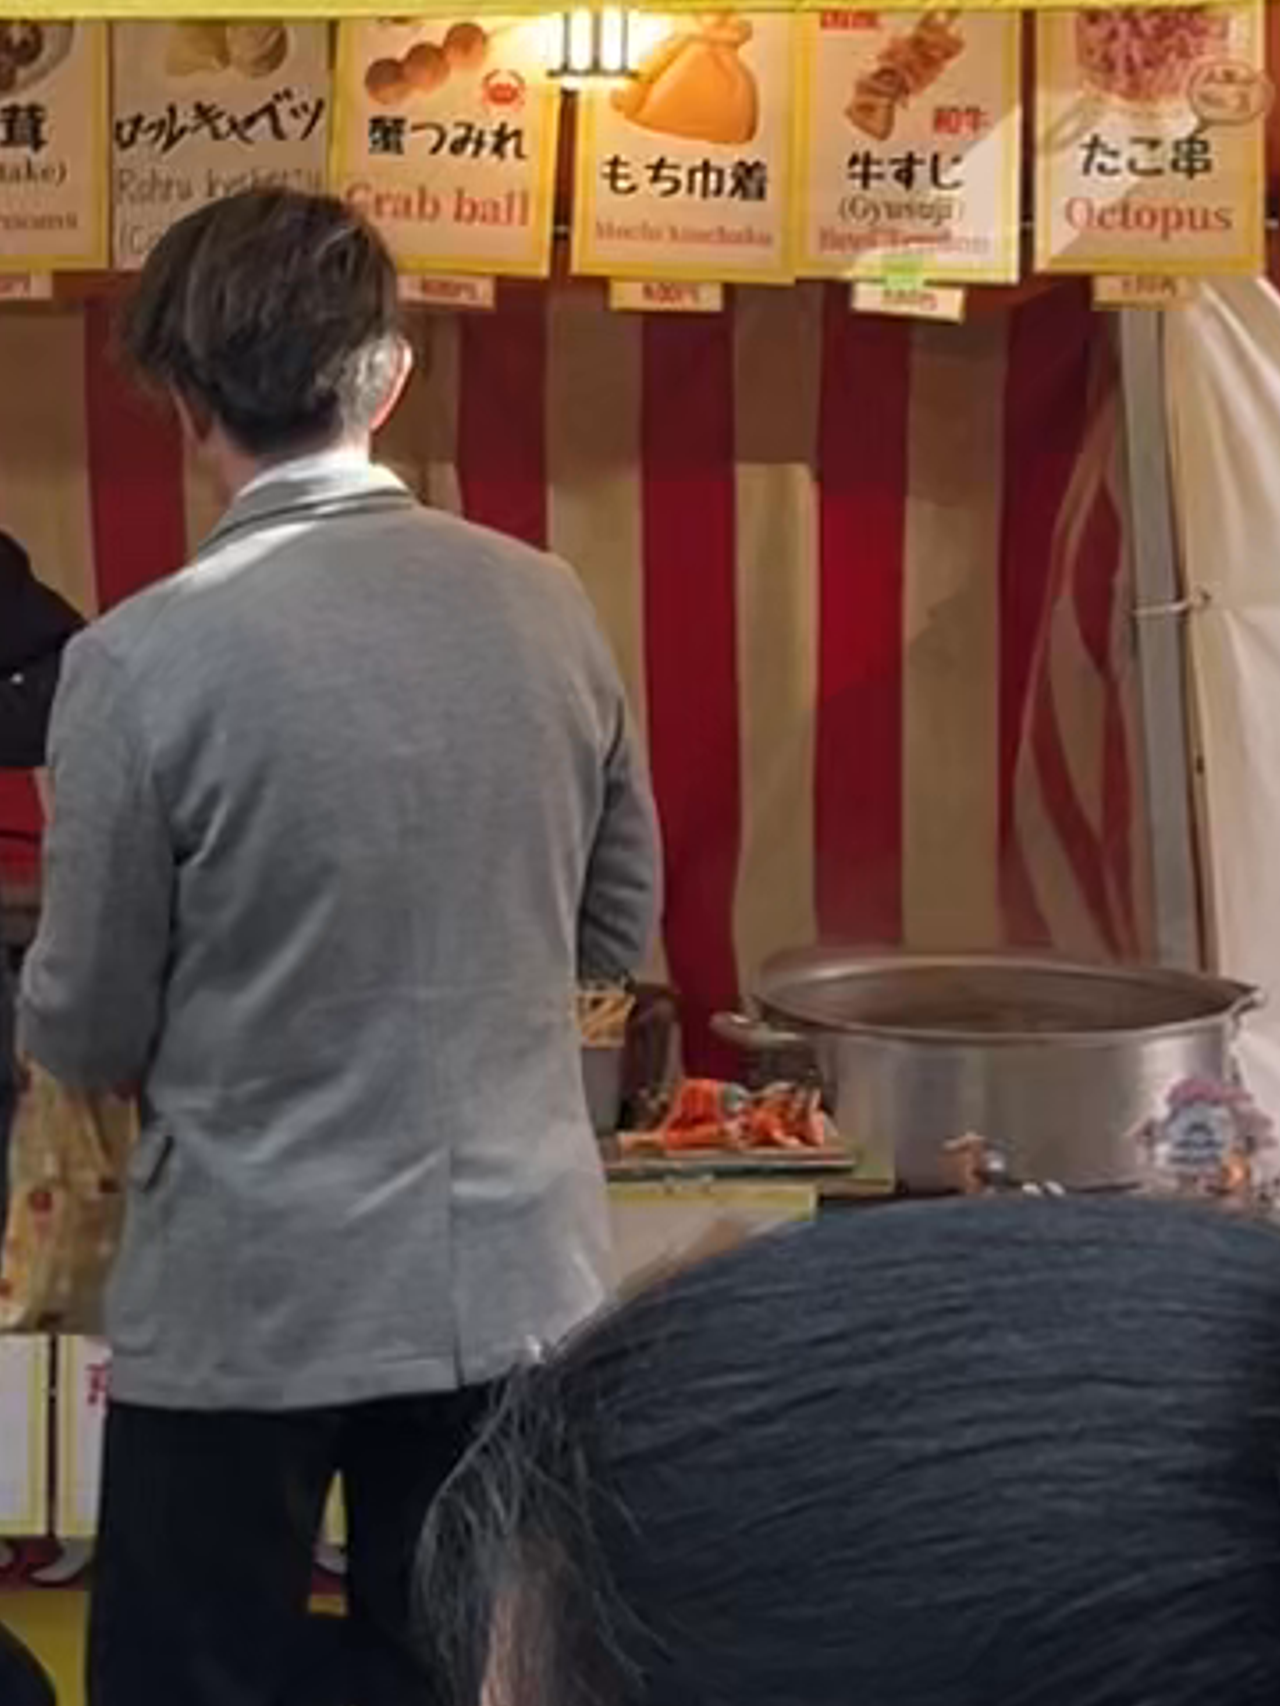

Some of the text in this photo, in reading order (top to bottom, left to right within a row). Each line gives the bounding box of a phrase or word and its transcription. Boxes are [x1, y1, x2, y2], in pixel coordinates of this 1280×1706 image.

[114, 87, 325, 154] ロールキャベツ
[368, 116, 528, 162] 蟹つみれ
[601, 154, 768, 201] もち巾着
[846, 150, 964, 192] 牛すじ
[1078, 133, 1213, 179] たこ串
[345, 180, 531, 229] Crab ball
[1064, 197, 1234, 240] Octopus
